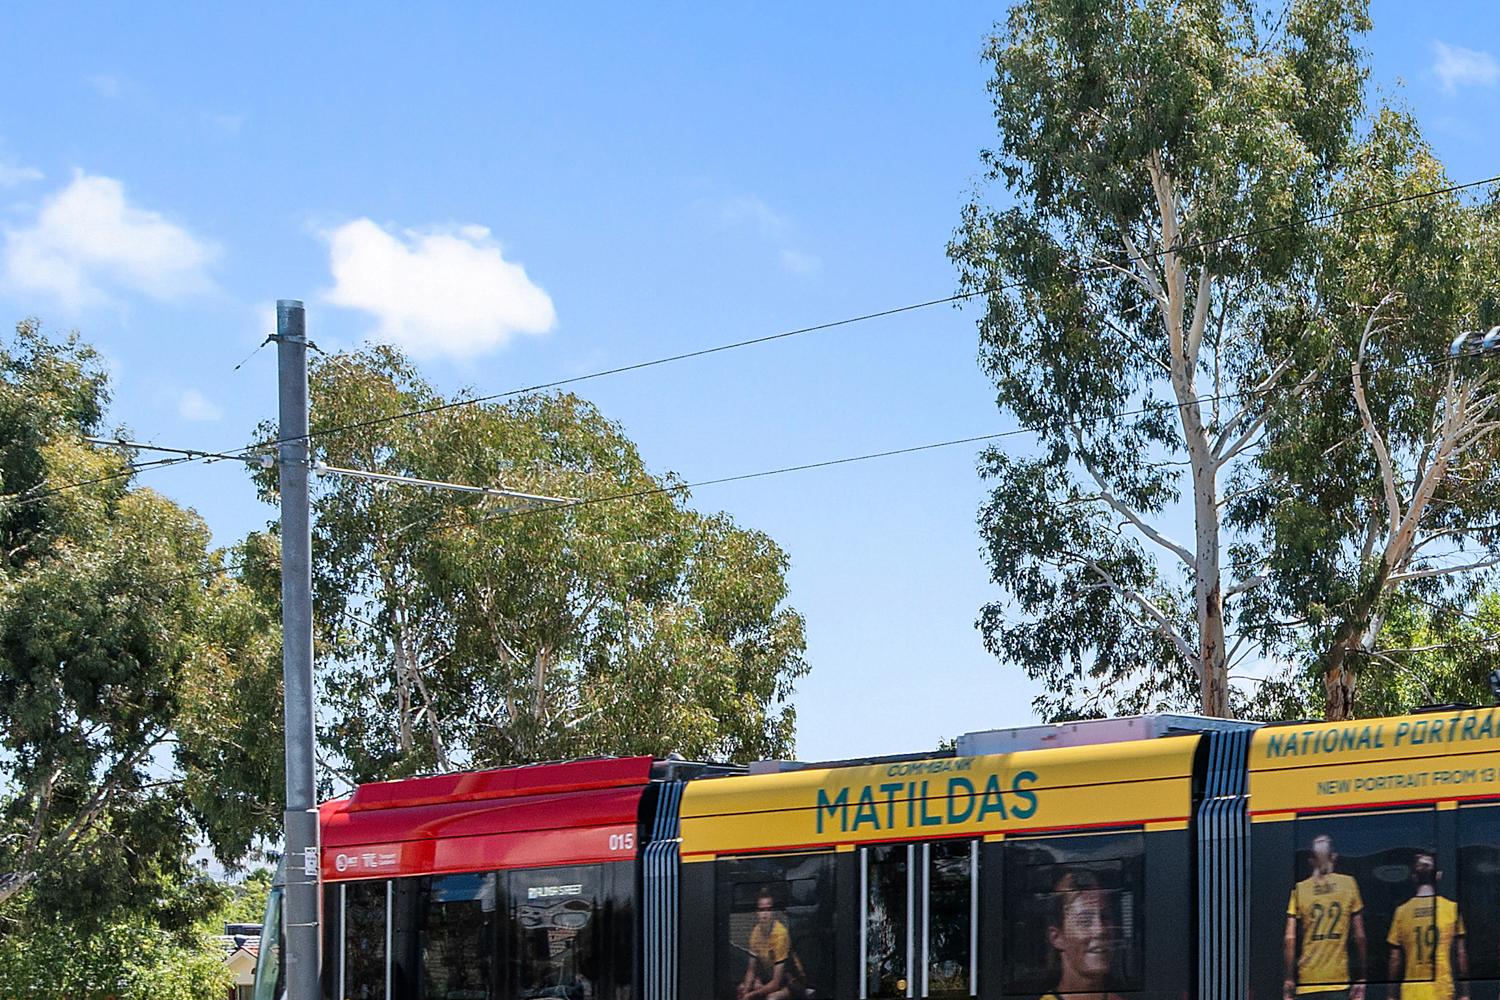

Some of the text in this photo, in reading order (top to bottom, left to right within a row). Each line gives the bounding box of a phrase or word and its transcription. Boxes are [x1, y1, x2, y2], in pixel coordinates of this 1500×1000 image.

[1267, 725, 1386, 758] NATIONAL
[887, 757, 975, 777] COMMBANK
[1317, 779, 1349, 795] NEW
[1354, 772, 1430, 791] PORTRAIT
[1432, 768, 1477, 785] FROM
[1481, 767, 1495, 782] 13
[816, 770, 1039, 834] MATILDAS
[609, 833, 634, 850] 015
[1310, 901, 1342, 941] 22
[1413, 924, 1440, 961] 19
